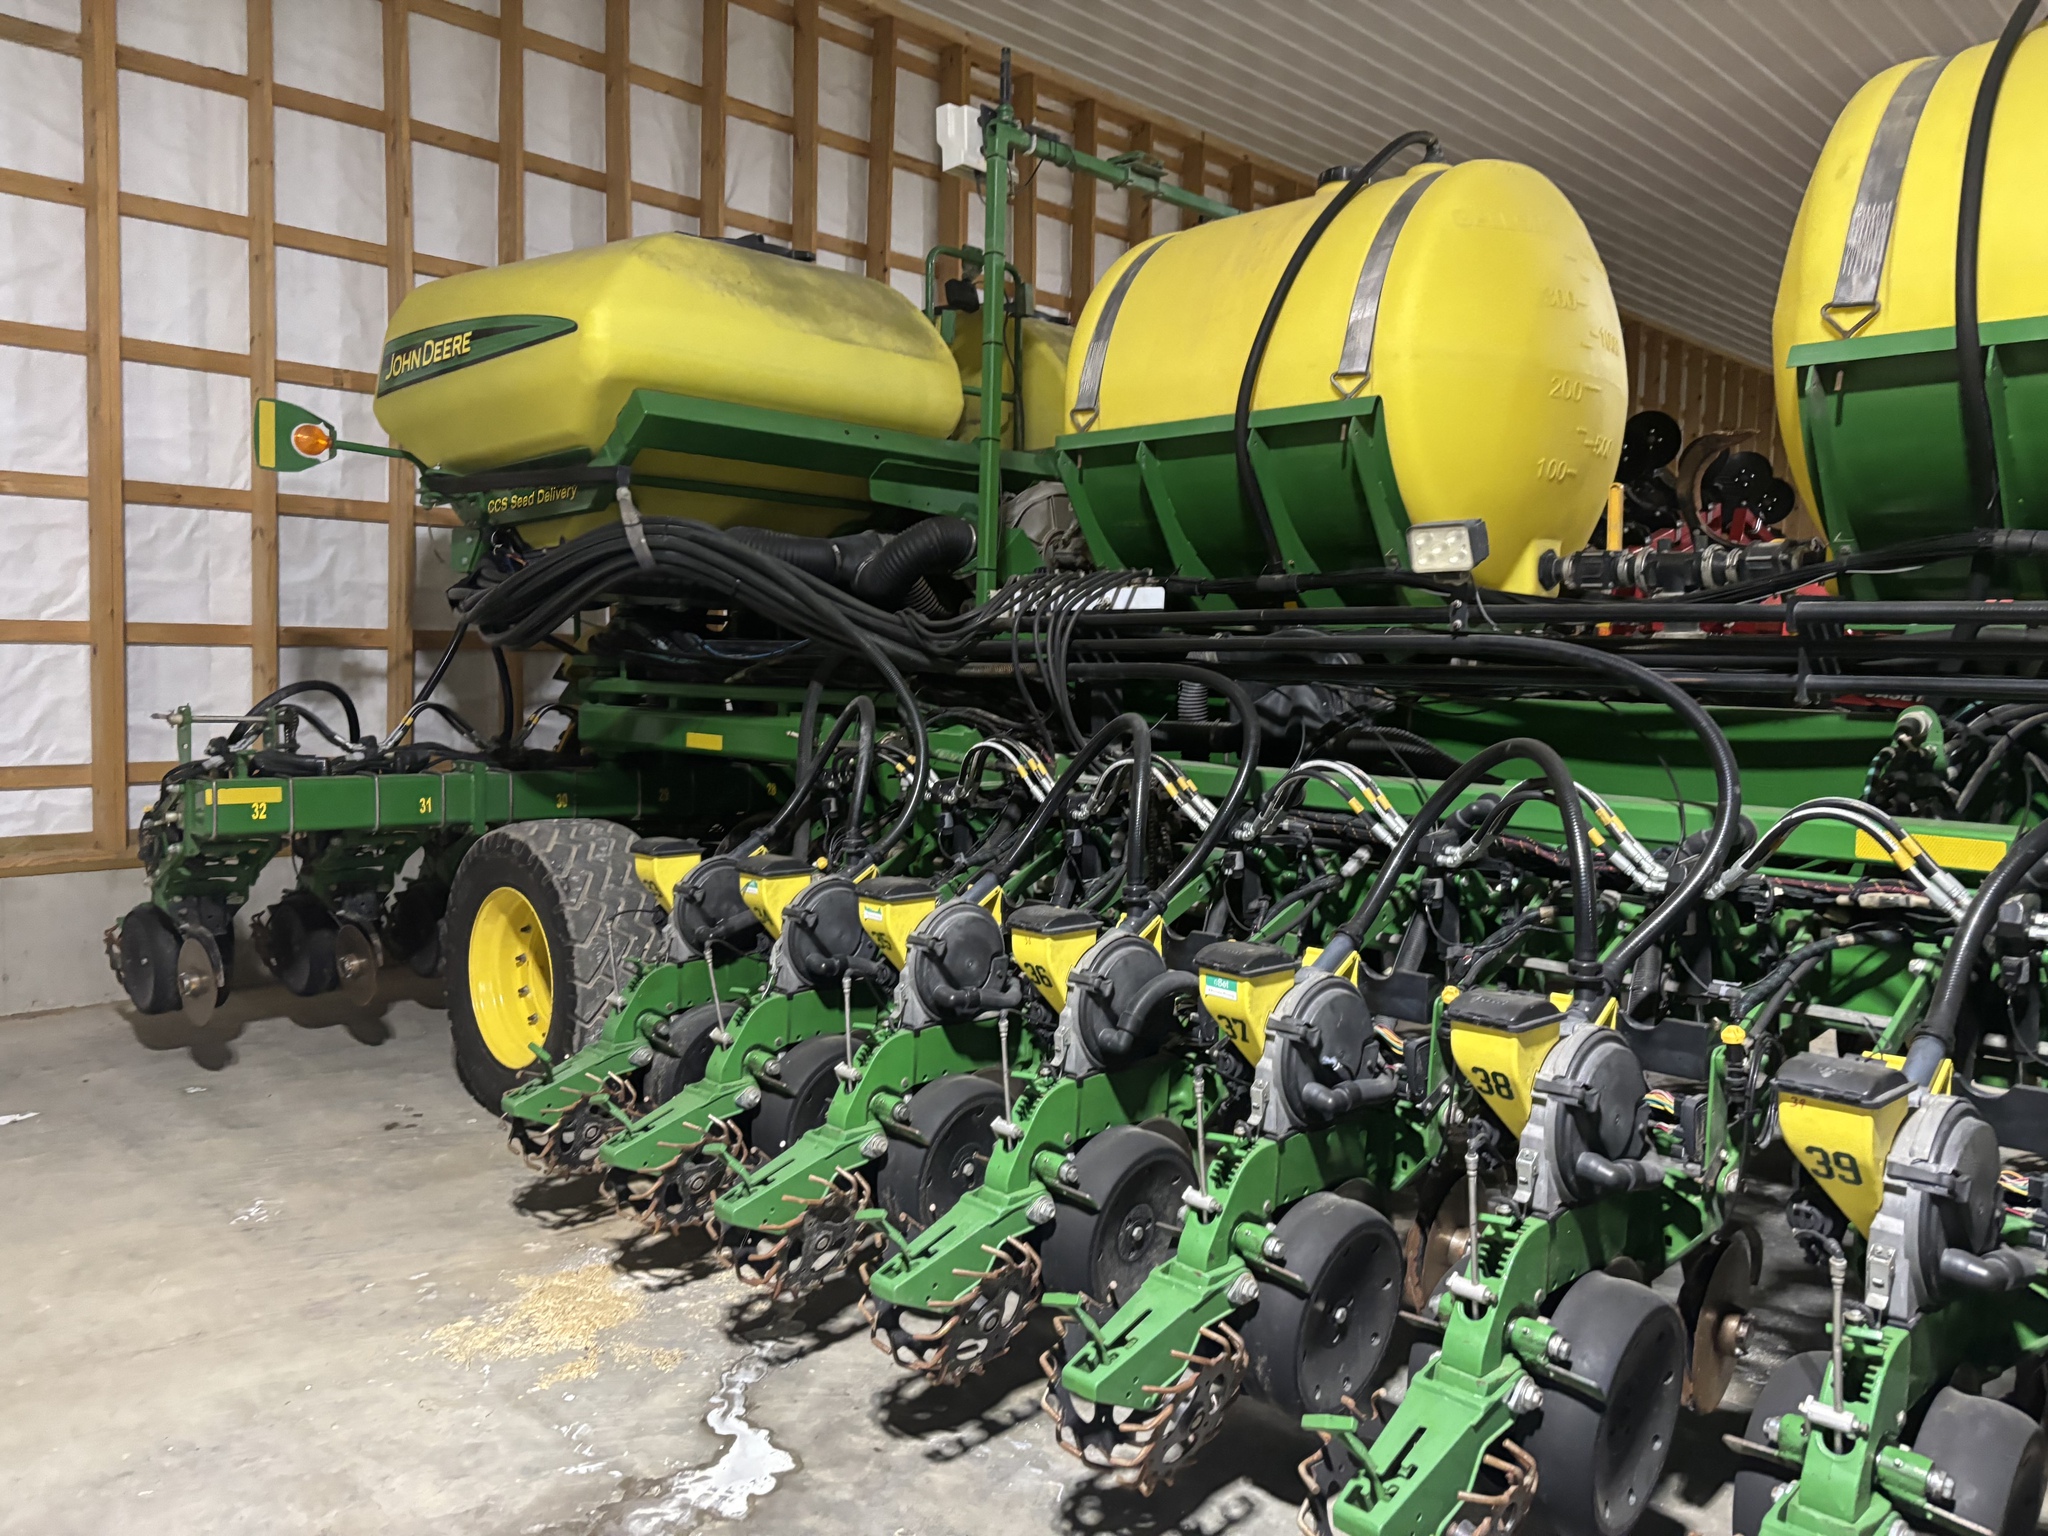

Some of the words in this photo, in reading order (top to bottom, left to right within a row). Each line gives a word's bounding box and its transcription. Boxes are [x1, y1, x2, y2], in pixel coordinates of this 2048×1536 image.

[385, 346, 422, 381] JOHN
[422, 330, 473, 367] DEERE
[1548, 376, 1583, 402] 200
[1537, 456, 1568, 482] 100
[487, 496, 509, 514] CCS
[510, 490, 536, 510] Seed
[537, 483, 578, 505] Delivery
[251, 802, 267, 820] 32
[419, 797, 432, 814] 31
[1024, 961, 1054, 988] 36
[1217, 1014, 1250, 1044] 37
[1471, 1066, 1515, 1101] 38
[1804, 1145, 1863, 1186] 39
